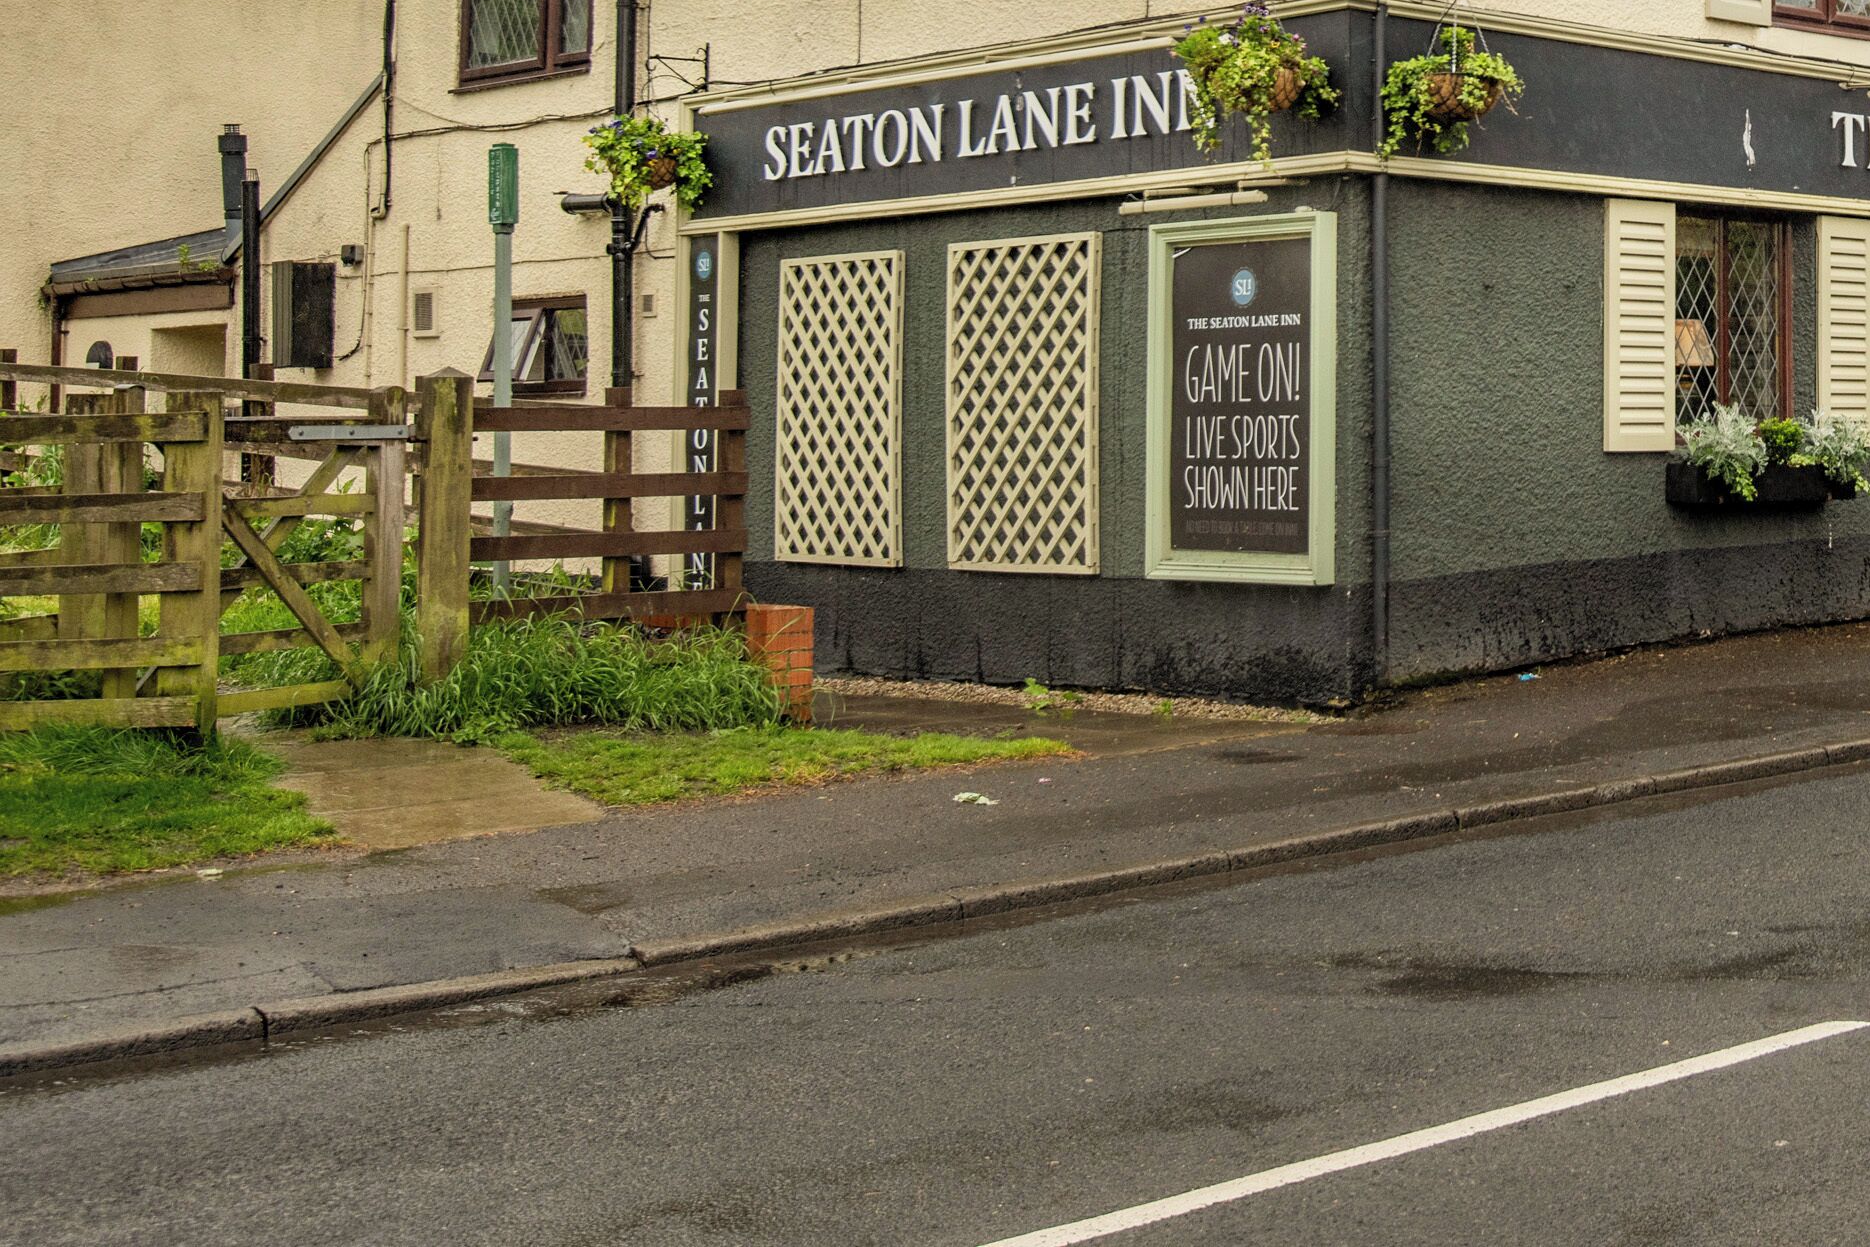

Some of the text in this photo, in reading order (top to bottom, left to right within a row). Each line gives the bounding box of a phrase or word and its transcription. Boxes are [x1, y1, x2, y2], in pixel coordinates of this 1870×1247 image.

[764, 103, 944, 181] SEATON
[957, 81, 1097, 158] LANE
[1187, 313, 1301, 330] THE SEATON LANE INN
[1186, 342, 1300, 403] GAME ON!
[1186, 414, 1300, 459] LIVE SPORTS
[1184, 465, 1300, 511] SHOWN HERE
